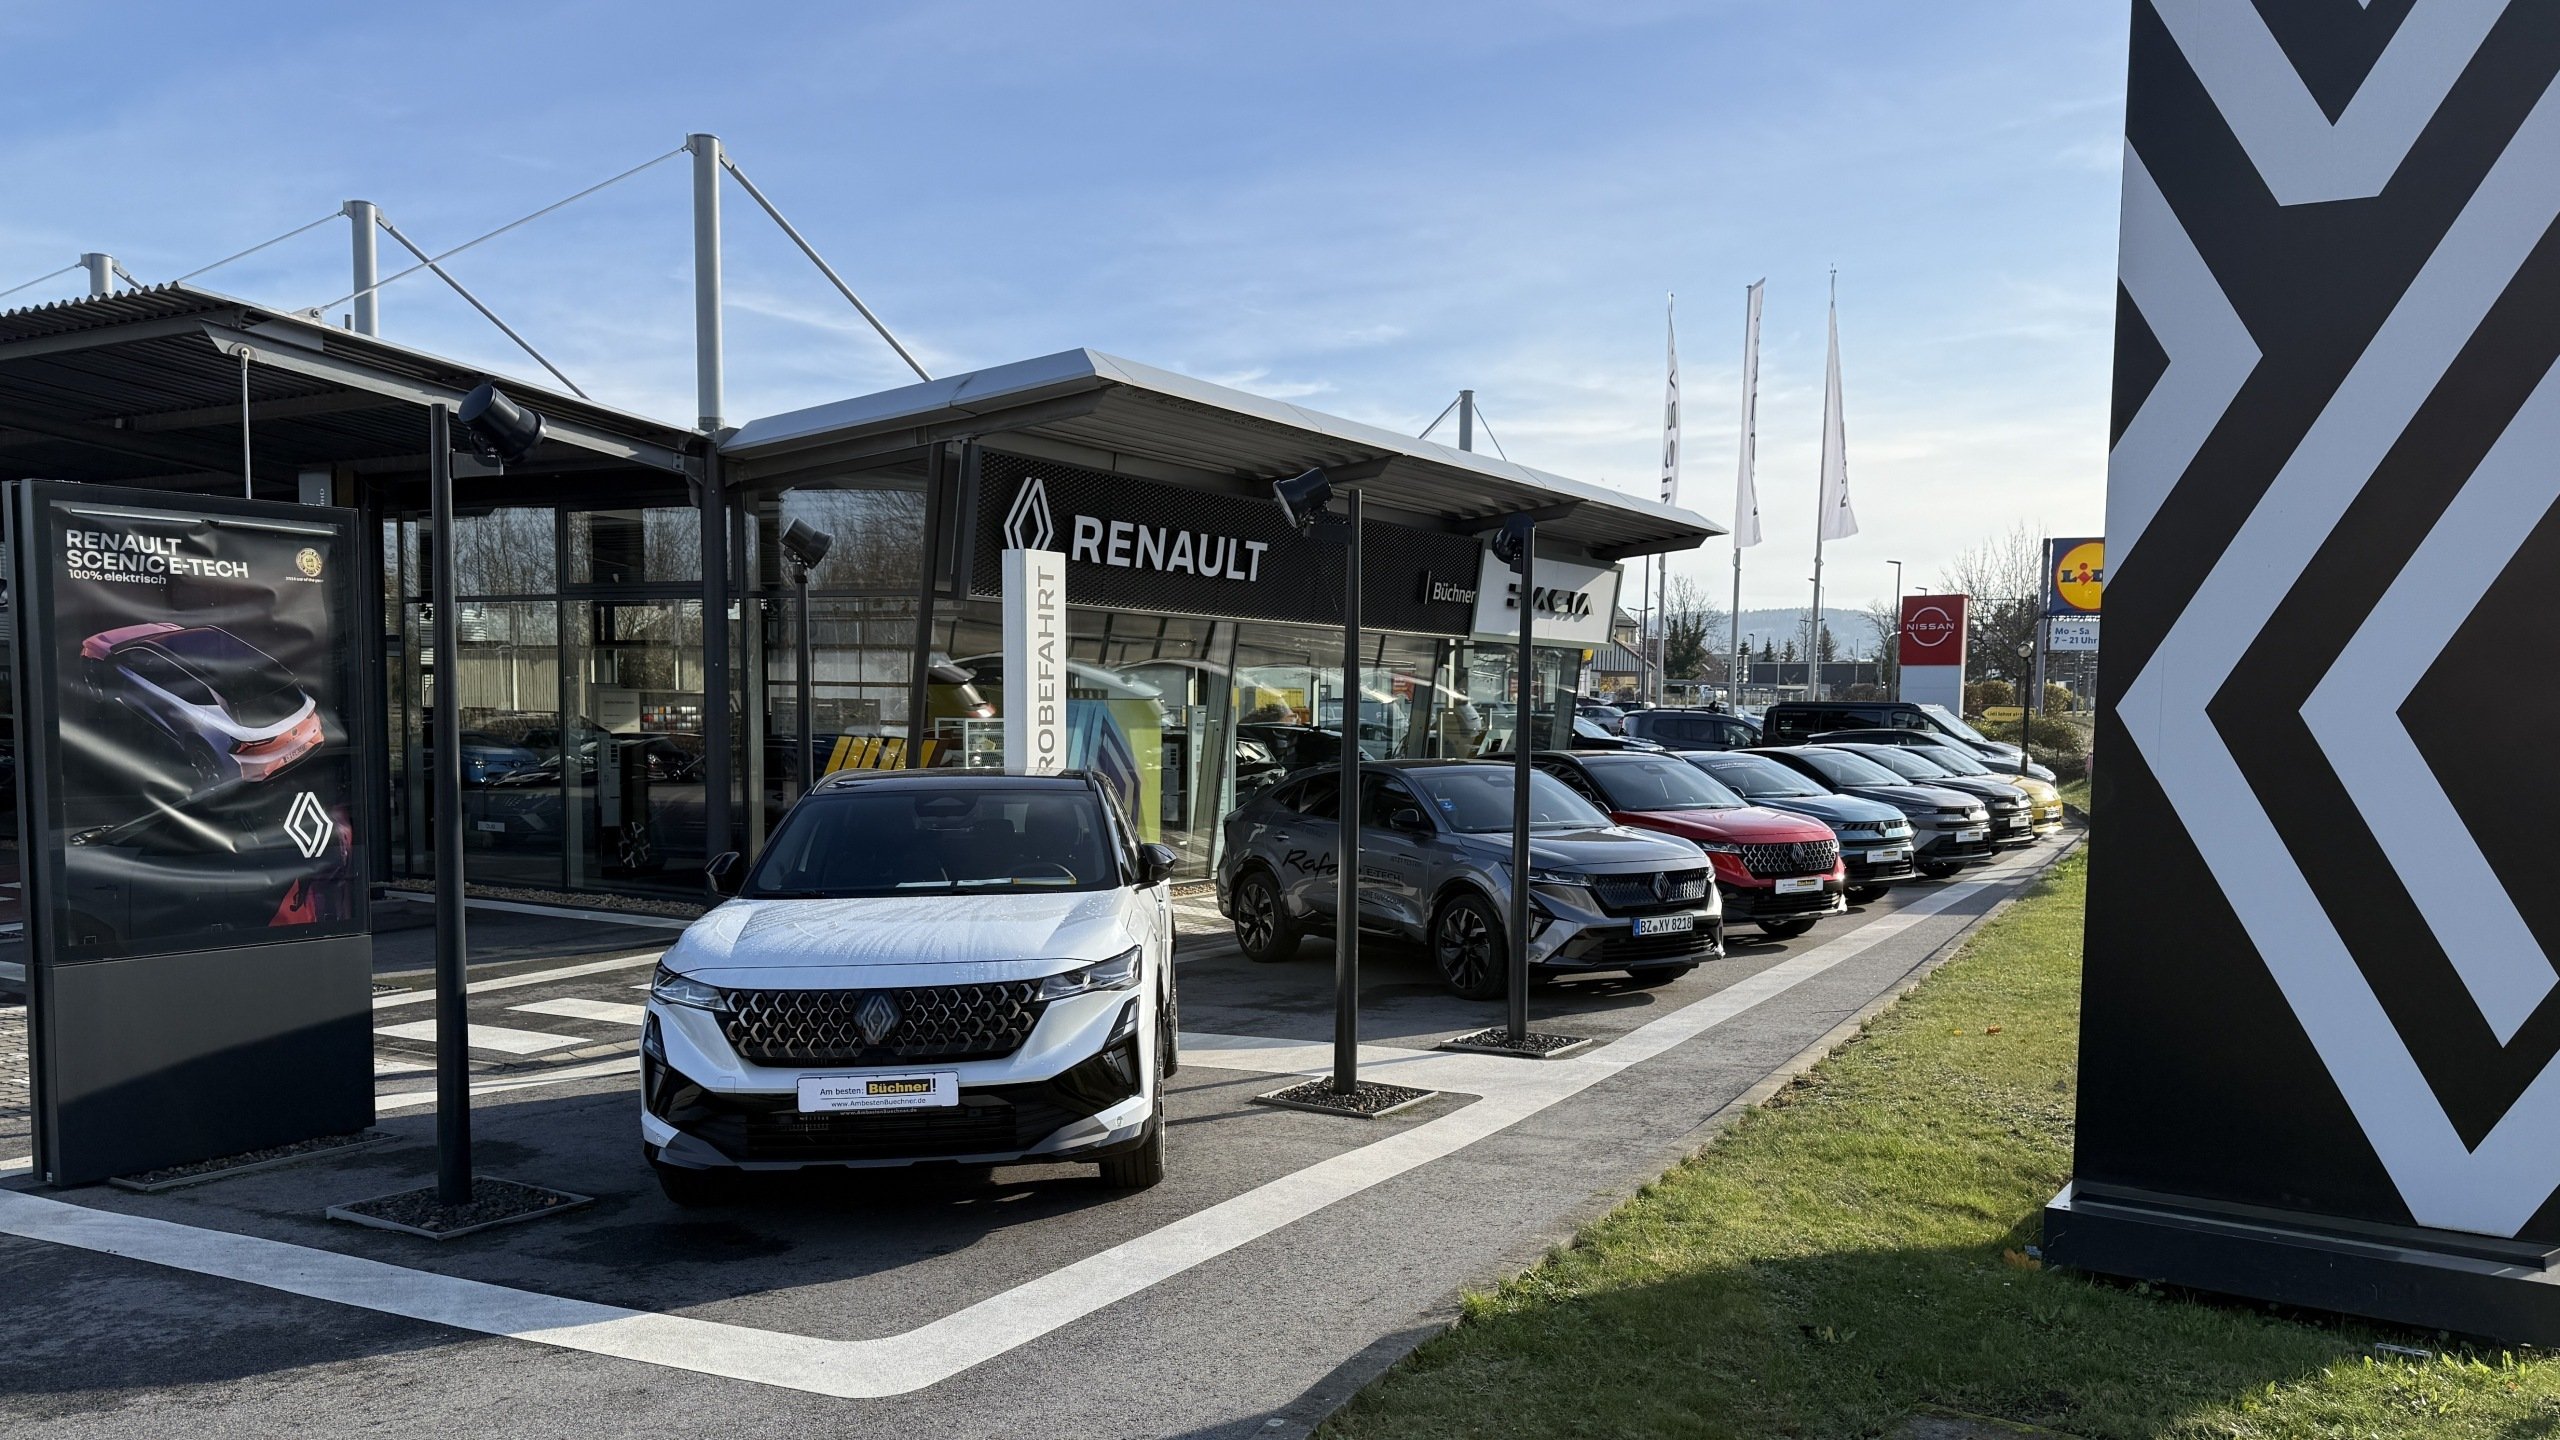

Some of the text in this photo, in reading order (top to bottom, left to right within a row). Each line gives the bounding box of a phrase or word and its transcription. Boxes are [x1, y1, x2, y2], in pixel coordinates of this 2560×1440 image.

[66, 529, 182, 556] RENAULT
[1072, 514, 1268, 583] RENAULT
[66, 549, 249, 579] SCENIC E-TECH
[68, 568, 167, 585] 100% elektrisch
[1433, 582, 1476, 604] Büchner
[1906, 623, 1955, 631] NISSAN
[1037, 565, 1055, 769] ROBEFAHRT
[1366, 868, 1401, 882] E-TECH
[1641, 917, 1692, 933] BZ XY 8218
[820, 1088, 833, 1096] Am
[836, 1087, 864, 1096] besten:
[831, 1097, 926, 1107] www.AmbestenBuechner.de
